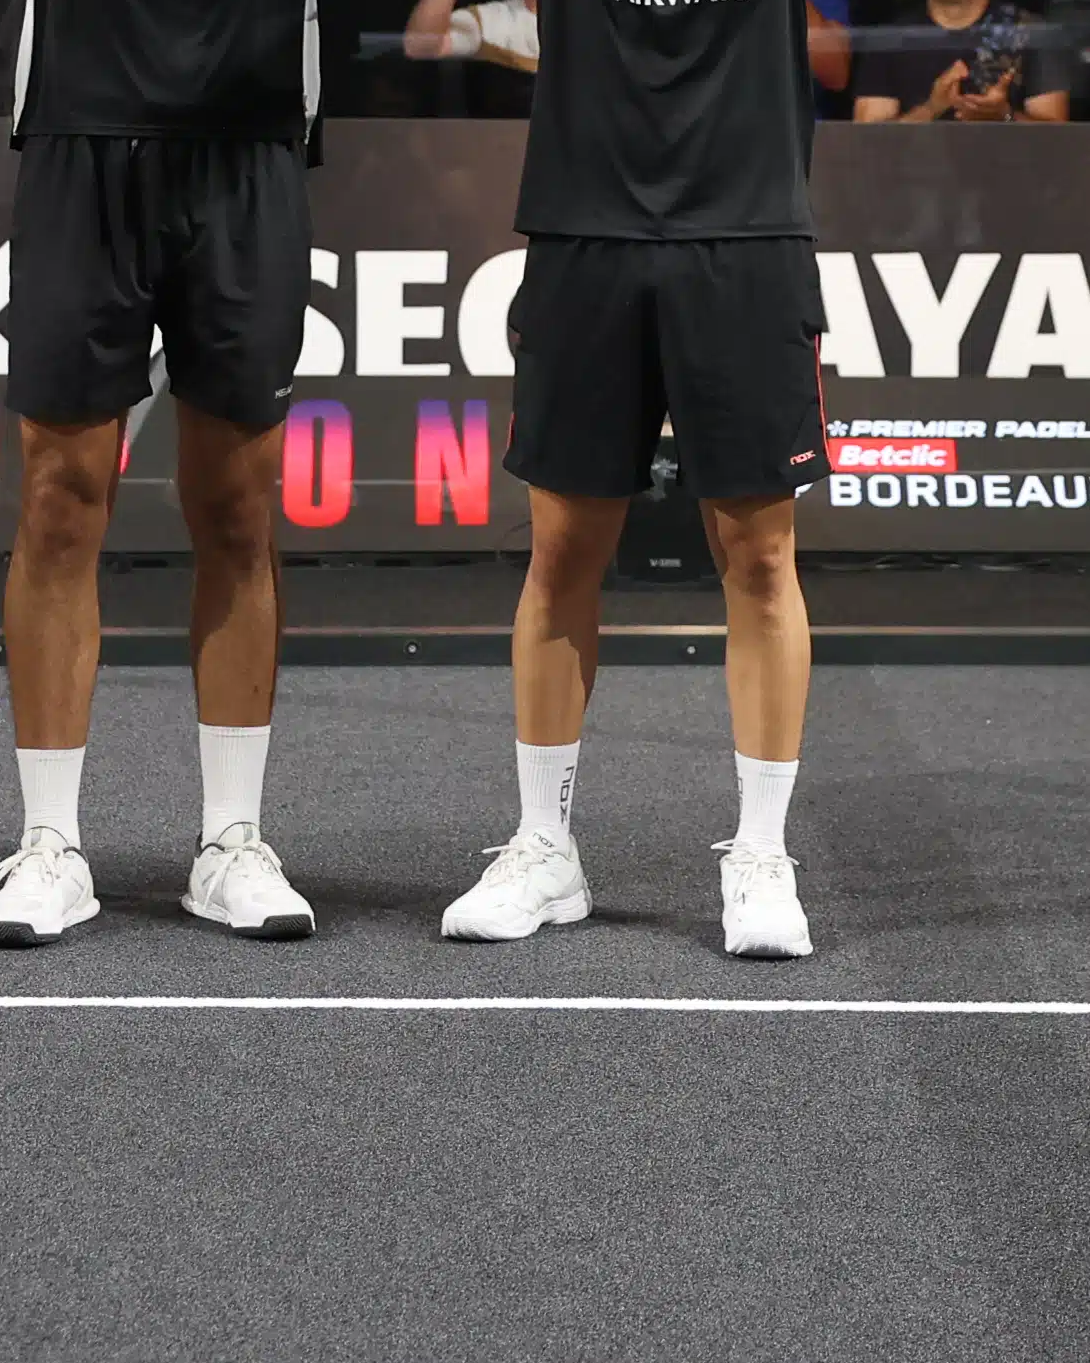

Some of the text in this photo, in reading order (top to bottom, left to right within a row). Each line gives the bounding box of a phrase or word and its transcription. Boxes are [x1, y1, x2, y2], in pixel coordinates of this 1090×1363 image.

[849, 419, 1090, 438] PREMIER PADEL
[837, 444, 948, 467] Betclic
[829, 474, 1090, 509] BORDEAU
